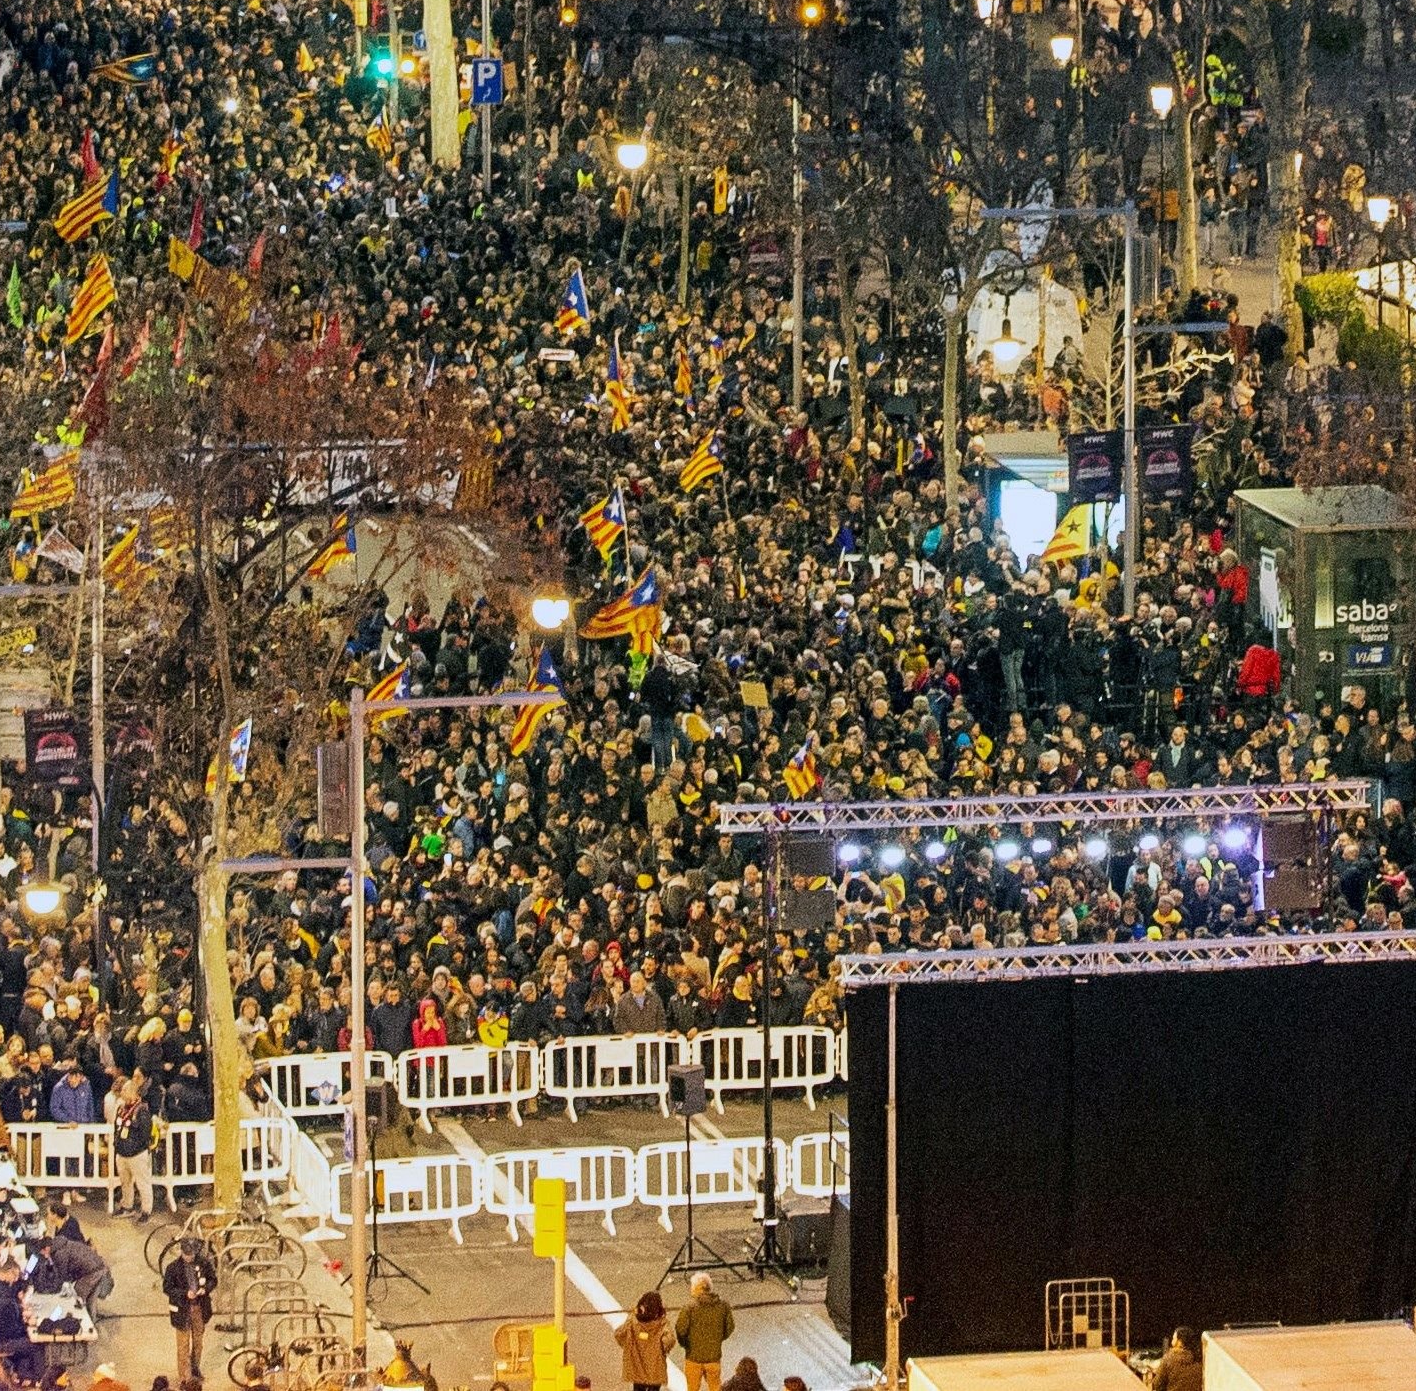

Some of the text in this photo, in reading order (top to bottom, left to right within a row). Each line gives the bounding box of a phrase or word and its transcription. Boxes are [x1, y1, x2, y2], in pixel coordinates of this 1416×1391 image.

[478, 62, 496, 87] P
[1336, 598, 1389, 623] saba
[1348, 623, 1389, 634] Barcelona
